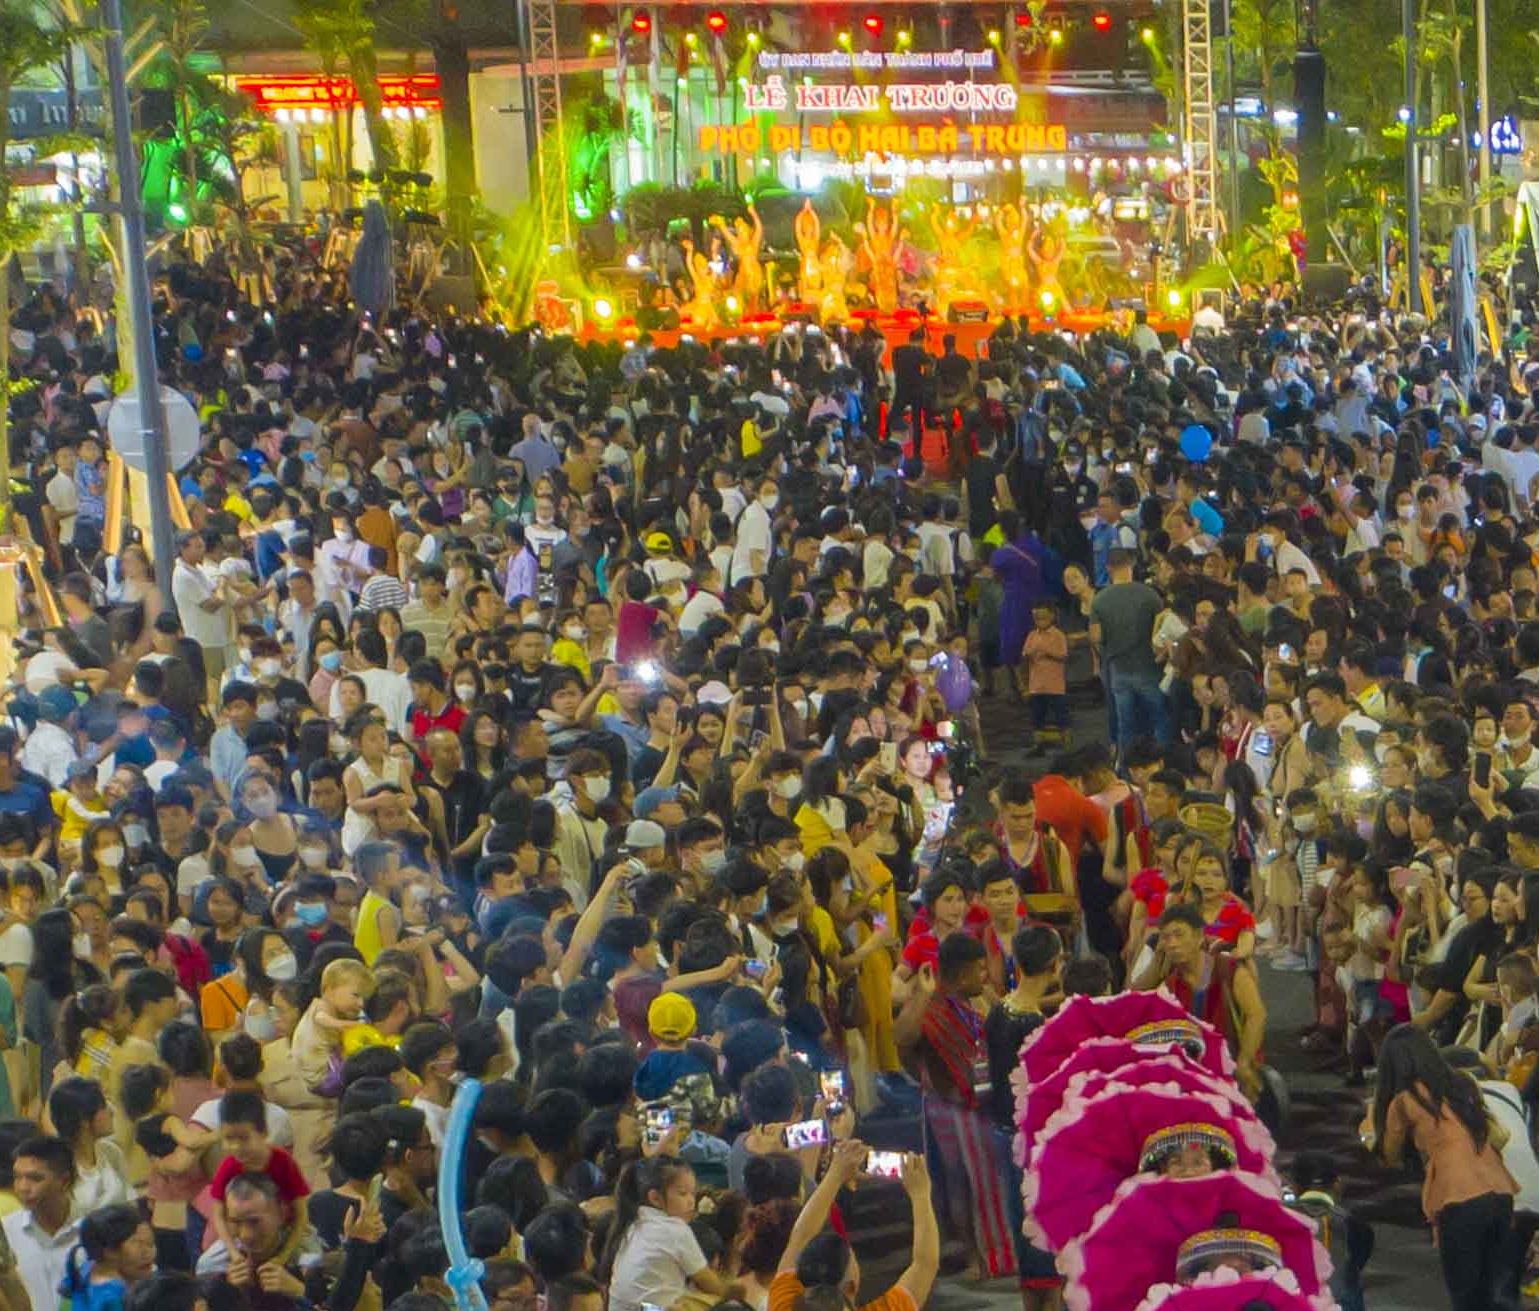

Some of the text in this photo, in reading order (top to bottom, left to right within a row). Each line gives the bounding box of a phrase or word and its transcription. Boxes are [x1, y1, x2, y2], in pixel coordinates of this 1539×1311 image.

[745, 75, 1017, 111] LỄ KHAI TRƯƠNG
[857, 124, 910, 153] HAI
[916, 117, 958, 153] BÀ
[966, 122, 1069, 156] TRƯNG
